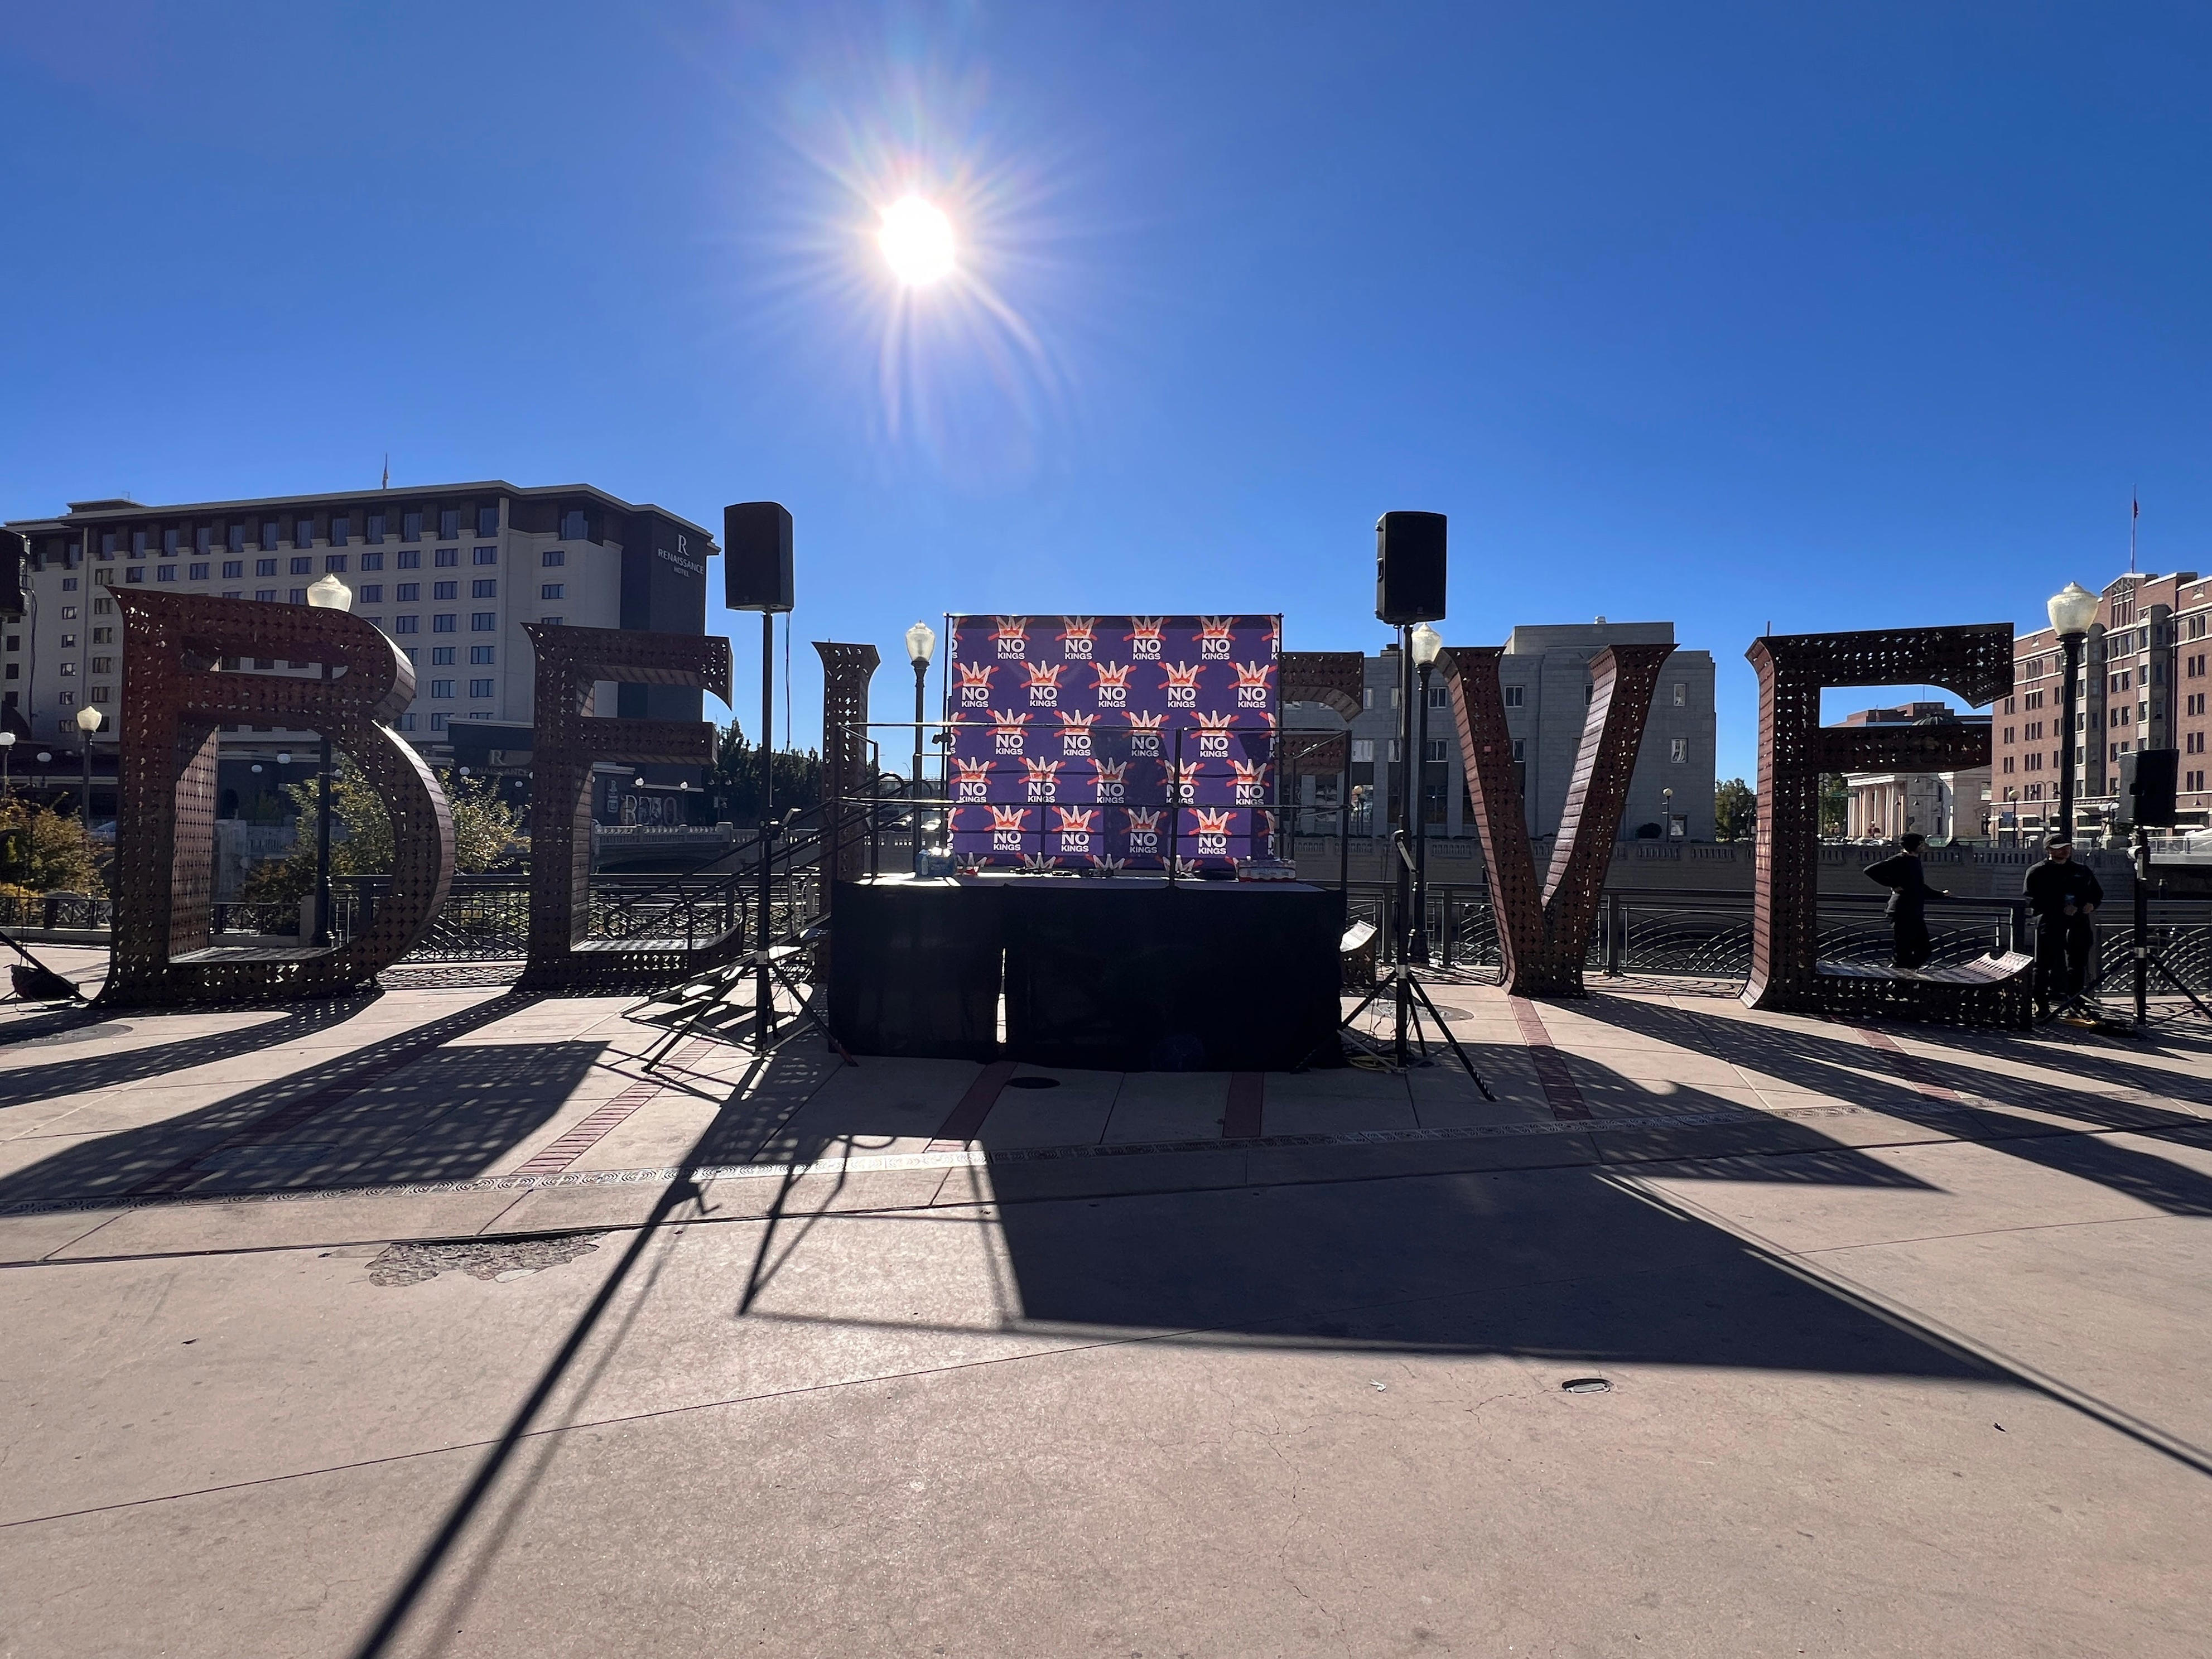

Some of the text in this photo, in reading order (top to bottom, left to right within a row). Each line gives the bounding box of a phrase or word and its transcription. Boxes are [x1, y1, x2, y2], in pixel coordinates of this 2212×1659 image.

[677, 534, 690, 556] R
[658, 548, 704, 575] RENAISSANCE
[673, 566, 690, 578] HOTEL
[997, 639, 1025, 653] NO
[1065, 639, 1093, 653] NO
[1133, 639, 1161, 653] NO
[1202, 639, 1230, 653] NO
[961, 687, 989, 701] NO
[1030, 687, 1058, 701] NO
[1098, 687, 1126, 701] NO
[1168, 687, 1196, 701] NO
[1238, 687, 1266, 701] NO
[996, 735, 1024, 748] NO
[1063, 735, 1091, 749] NO
[1131, 736, 1159, 750] NO
[1200, 737, 1228, 750] NO
[470, 766, 529, 777] ENAISSANCE
[959, 783, 987, 796] NO
[1028, 783, 1056, 796] NO
[1097, 783, 1125, 797] NO
[1167, 784, 1194, 798] NO
[1236, 784, 1264, 798] NO
[994, 832, 1021, 844] NO
[1061, 832, 1089, 845] NO
[1130, 833, 1158, 847] NO
[1199, 834, 1227, 847] NO
